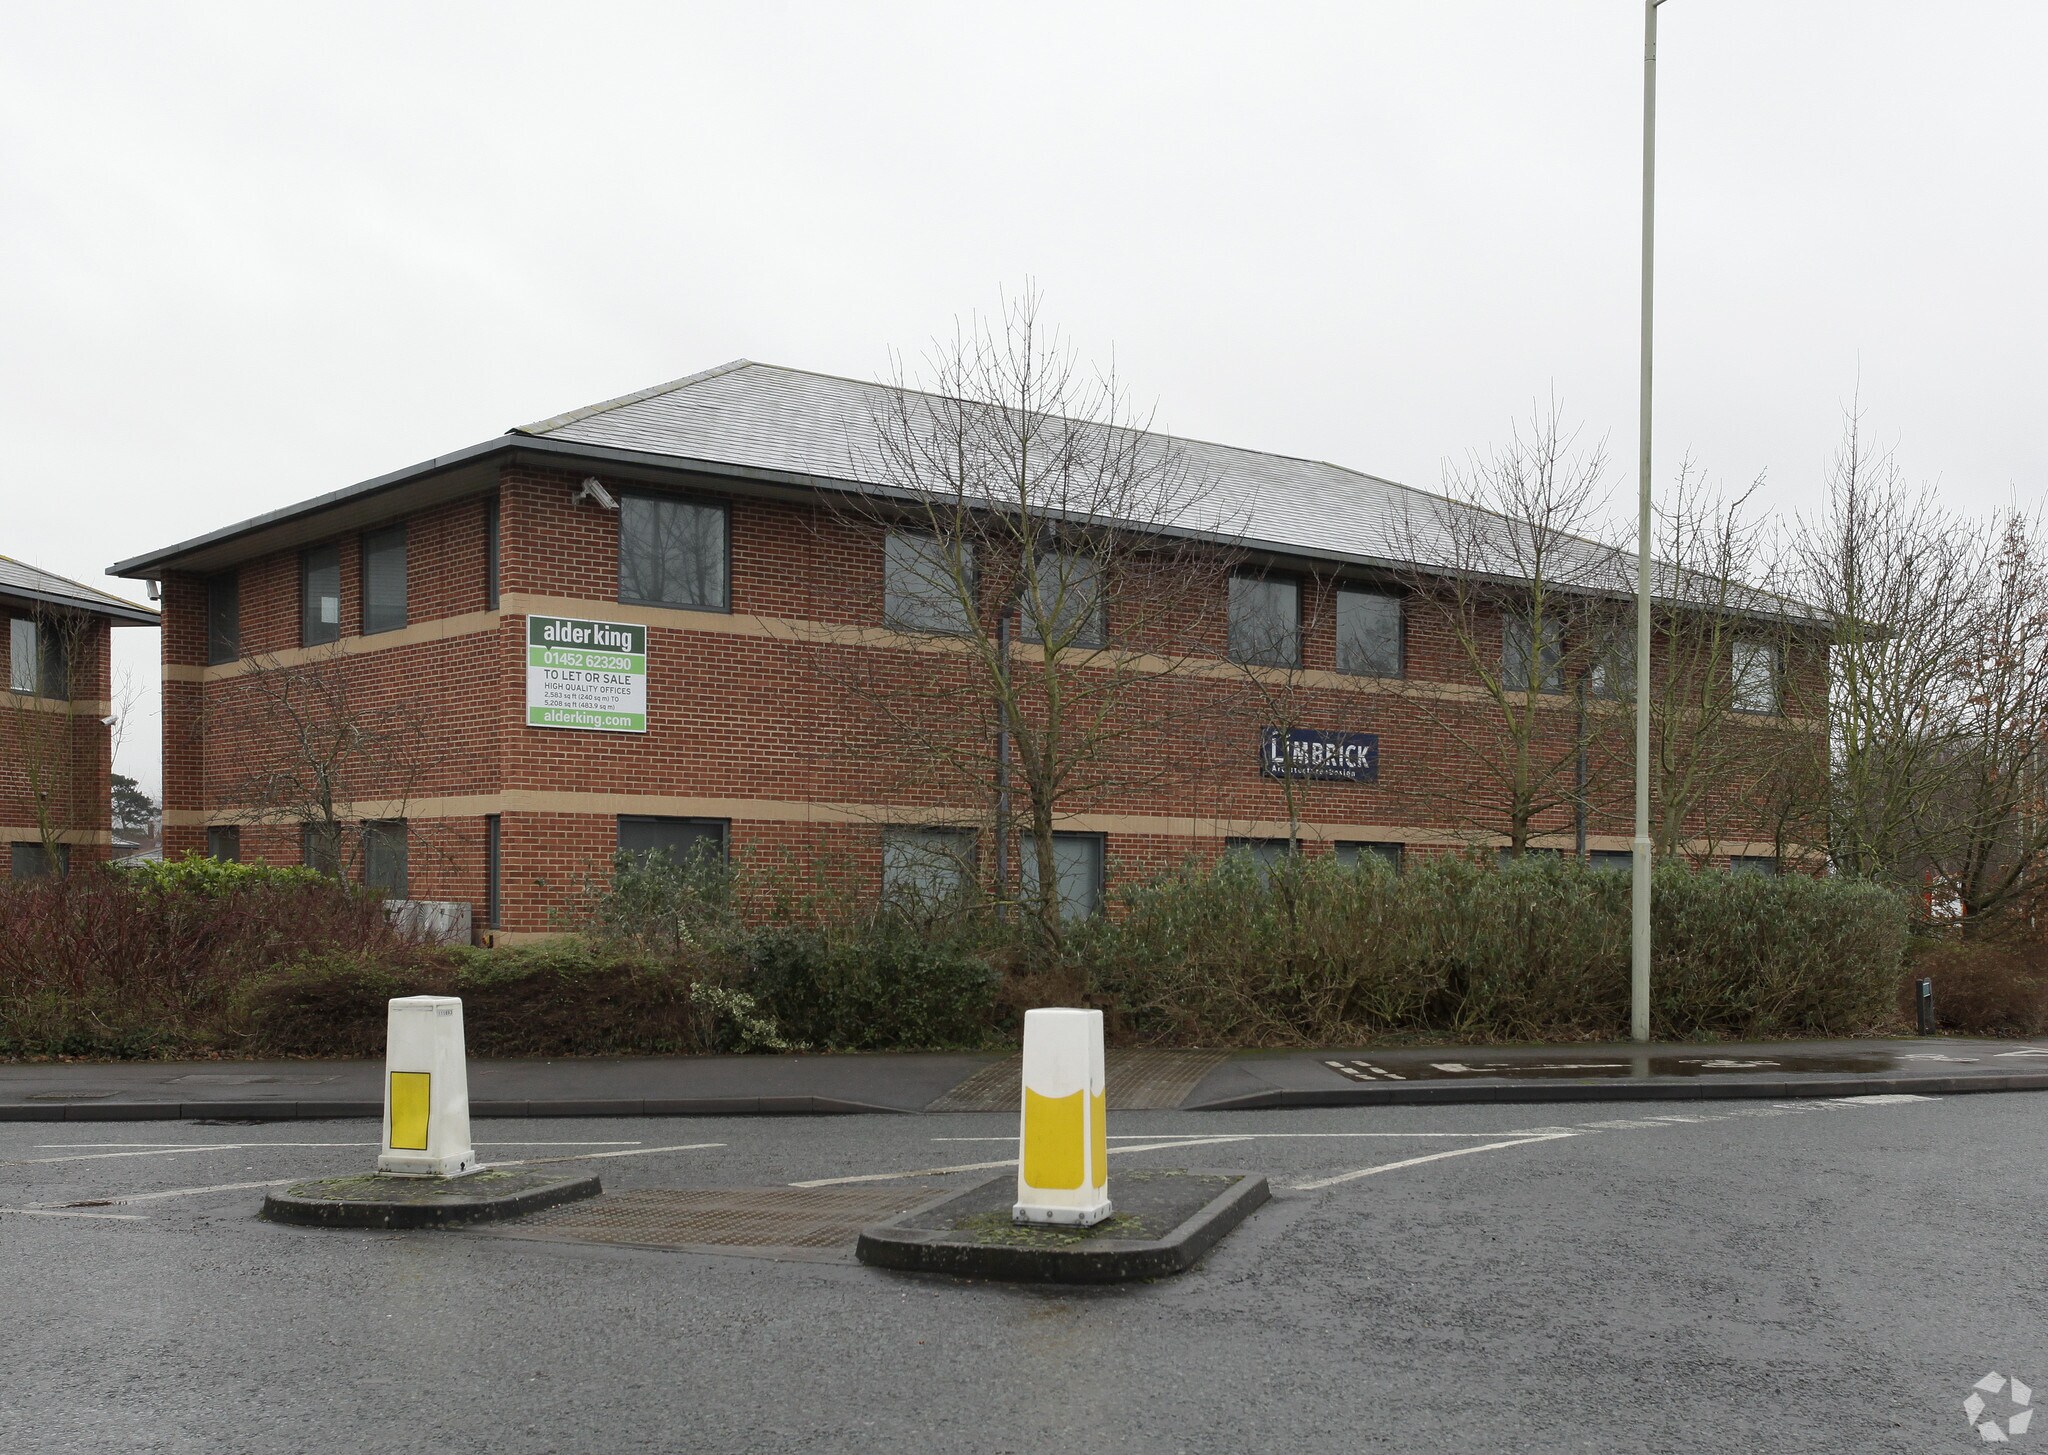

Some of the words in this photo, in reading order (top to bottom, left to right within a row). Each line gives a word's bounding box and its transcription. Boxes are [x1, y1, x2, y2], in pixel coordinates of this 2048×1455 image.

[544, 621, 591, 643] alder
[594, 624, 632, 652] king
[544, 652, 583, 666] 01452
[586, 655, 631, 670] 623290
[544, 670, 558, 679] TO
[562, 671, 581, 681] LET
[585, 673, 600, 682] OR
[604, 674, 631, 685] SALE
[566, 685, 598, 693] QUALITY
[600, 687, 631, 695] OFFICES
[544, 710, 631, 727] alderking.com
